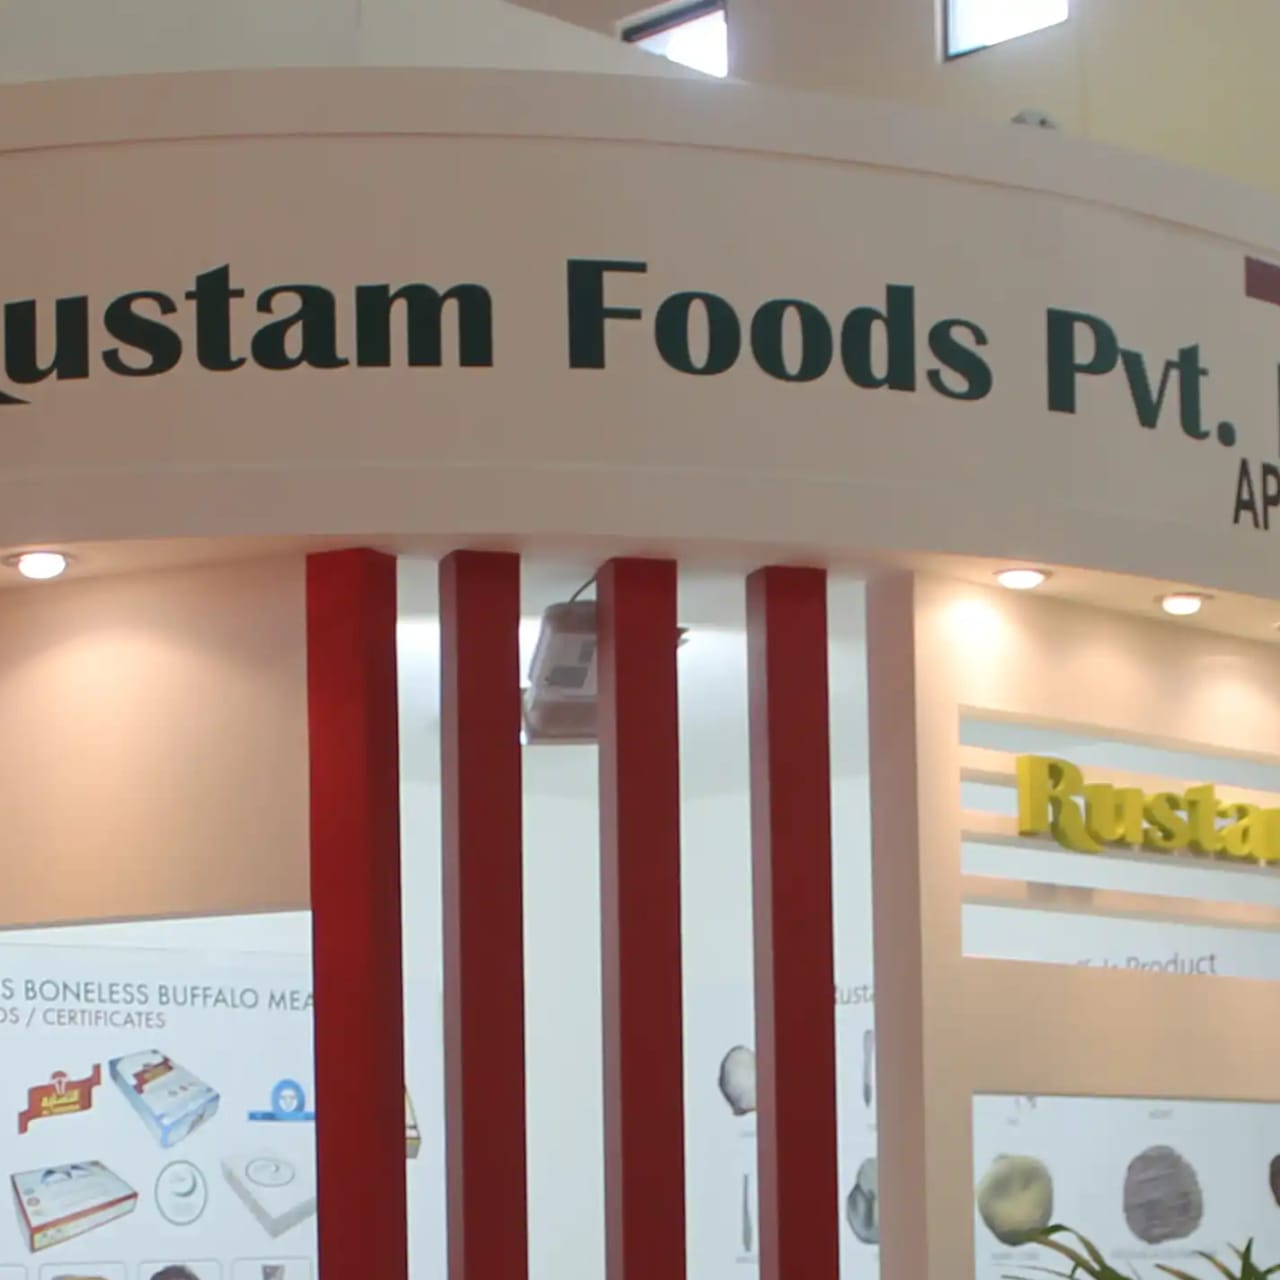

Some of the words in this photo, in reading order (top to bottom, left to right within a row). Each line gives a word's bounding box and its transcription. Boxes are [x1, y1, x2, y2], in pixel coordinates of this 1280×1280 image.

[566, 258, 994, 402] Foods
[1045, 307, 1238, 448] Pvt.
[23, 978, 149, 1006] BONELESS
[157, 984, 260, 1010] BUFFALO
[268, 989, 316, 1012] MEA
[42, 1007, 166, 1030] CERTIFICATES
